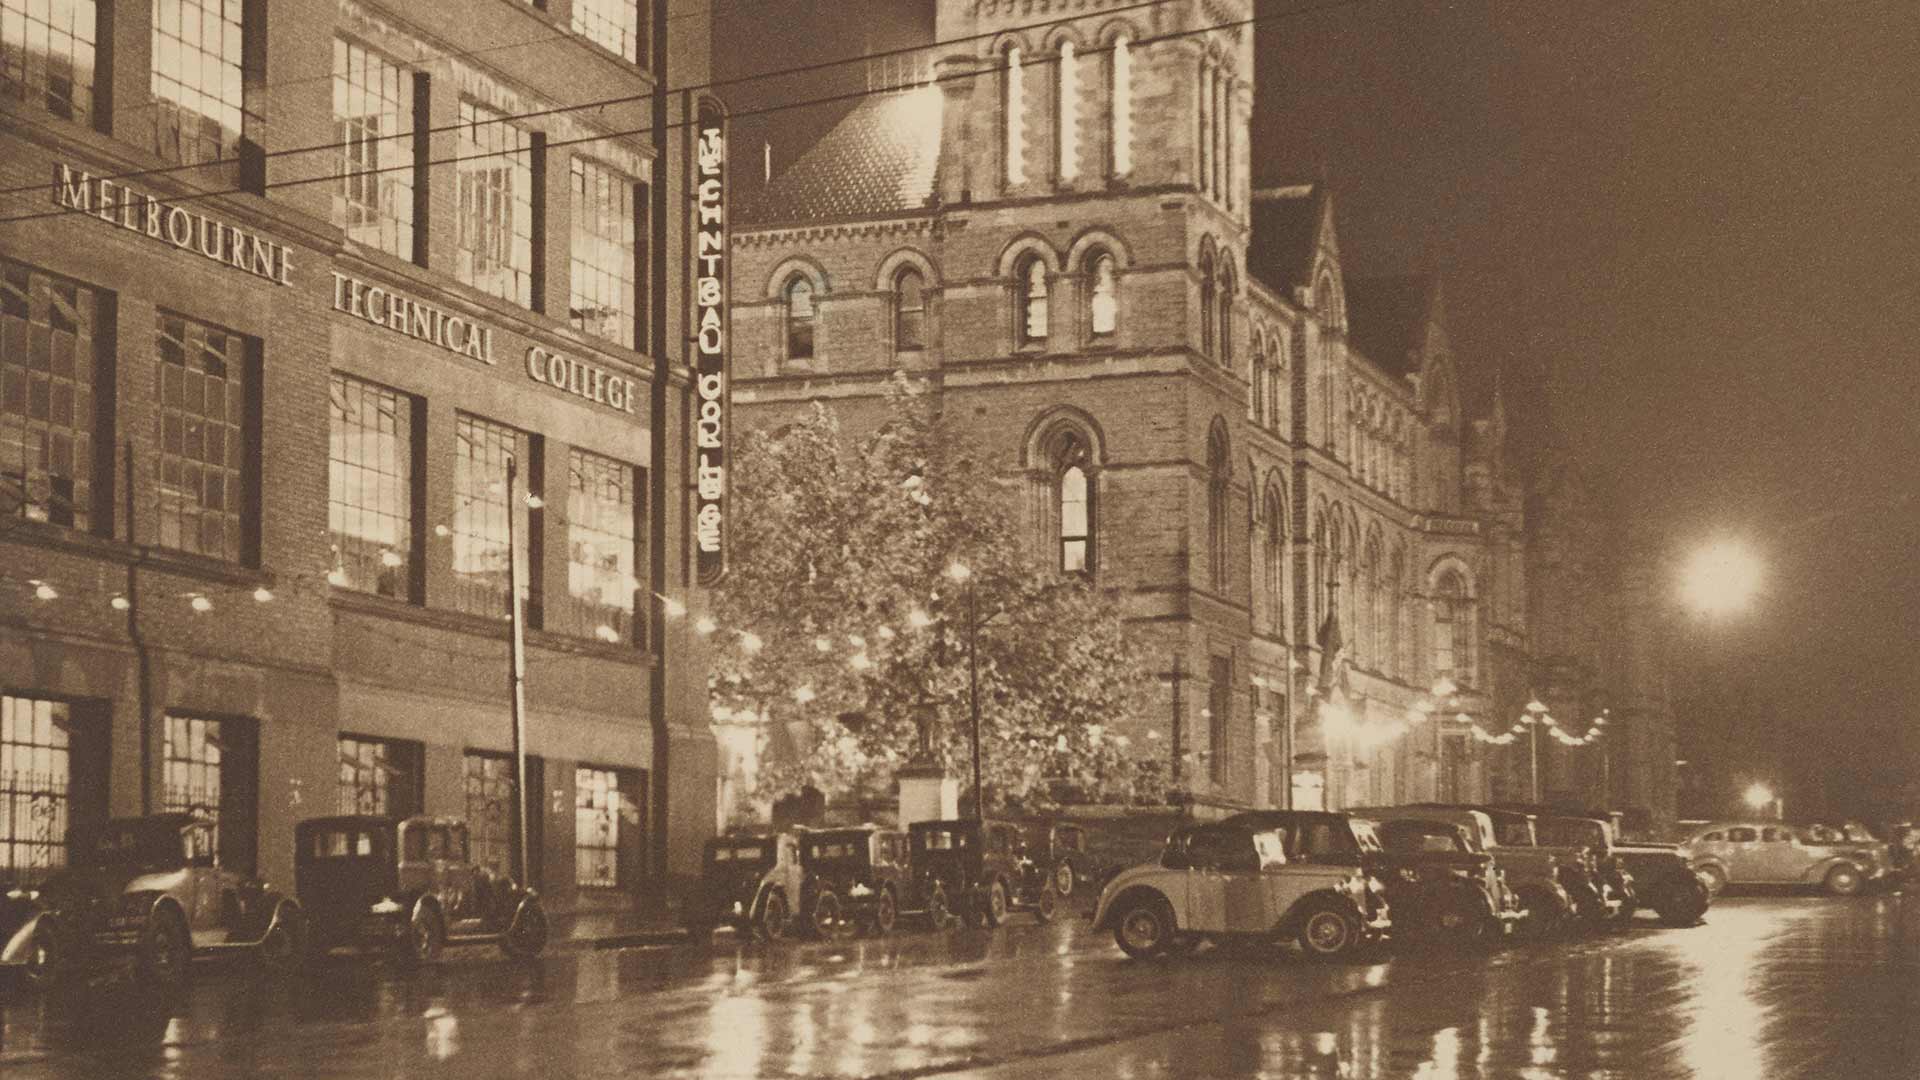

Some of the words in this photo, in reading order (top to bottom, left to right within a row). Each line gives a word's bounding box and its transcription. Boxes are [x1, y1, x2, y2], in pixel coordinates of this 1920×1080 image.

[56, 162, 295, 287] MELBOURNE
[331, 270, 497, 366] TECHNICAL
[527, 346, 636, 414] COLLEGE
